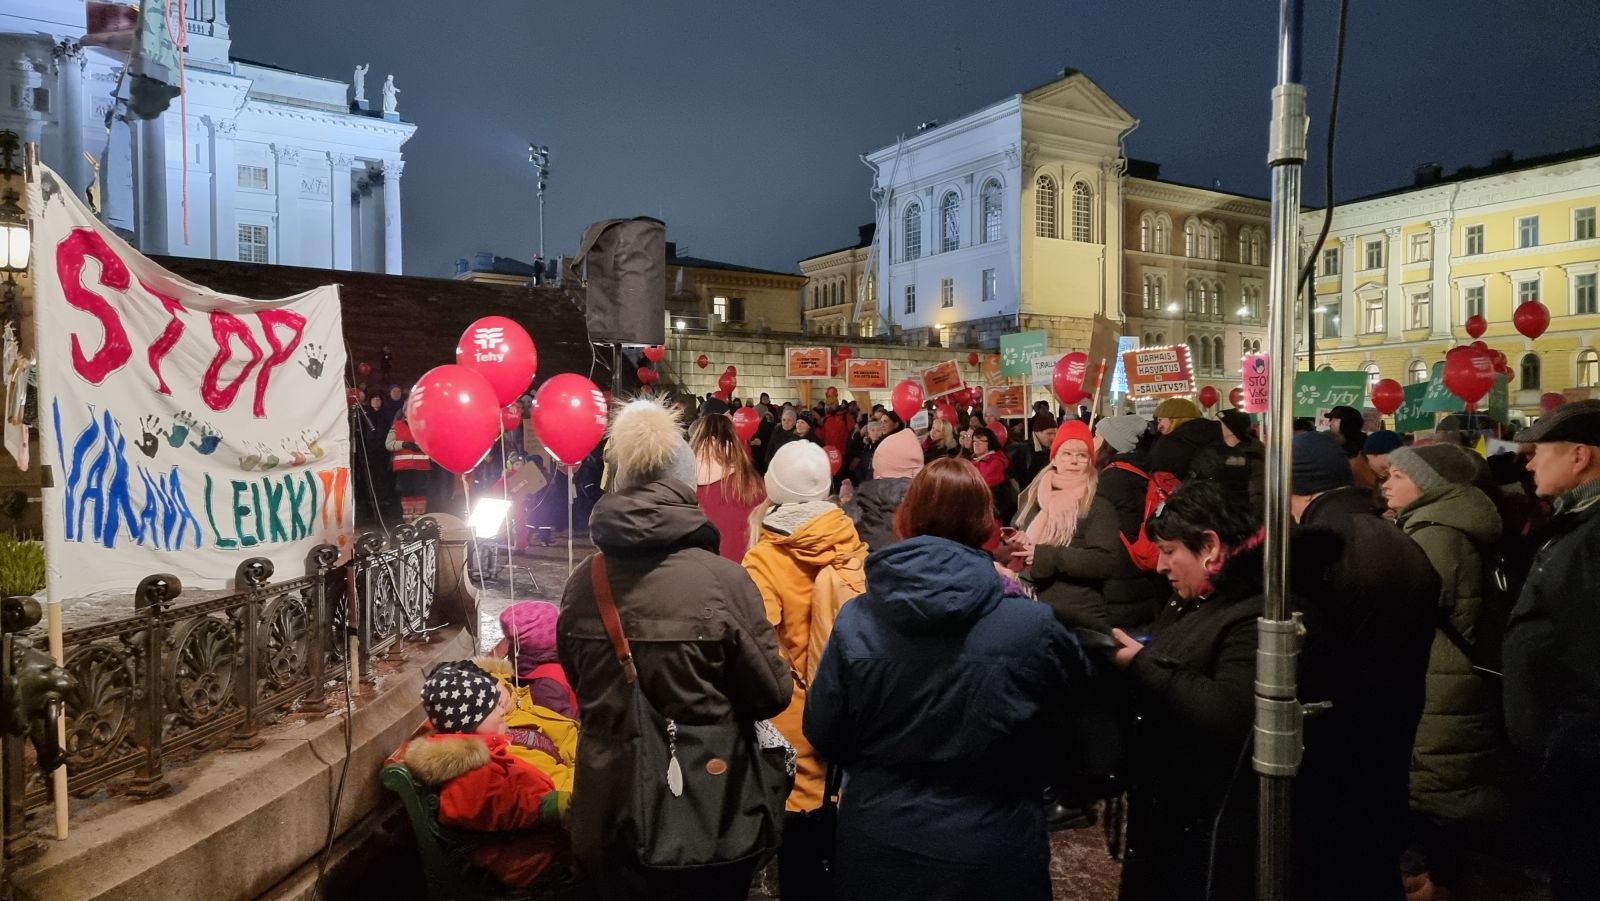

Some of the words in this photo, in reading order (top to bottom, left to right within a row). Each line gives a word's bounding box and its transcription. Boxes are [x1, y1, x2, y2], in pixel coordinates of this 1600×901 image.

[56, 226, 307, 419] STOP
[474, 351, 505, 363] Tehy
[1138, 352, 1175, 363] VARHAIS-
[1138, 363, 1179, 374] KASVATUS
[1322, 390, 1359, 406] Jyty
[52, 395, 203, 551] VAKAVA
